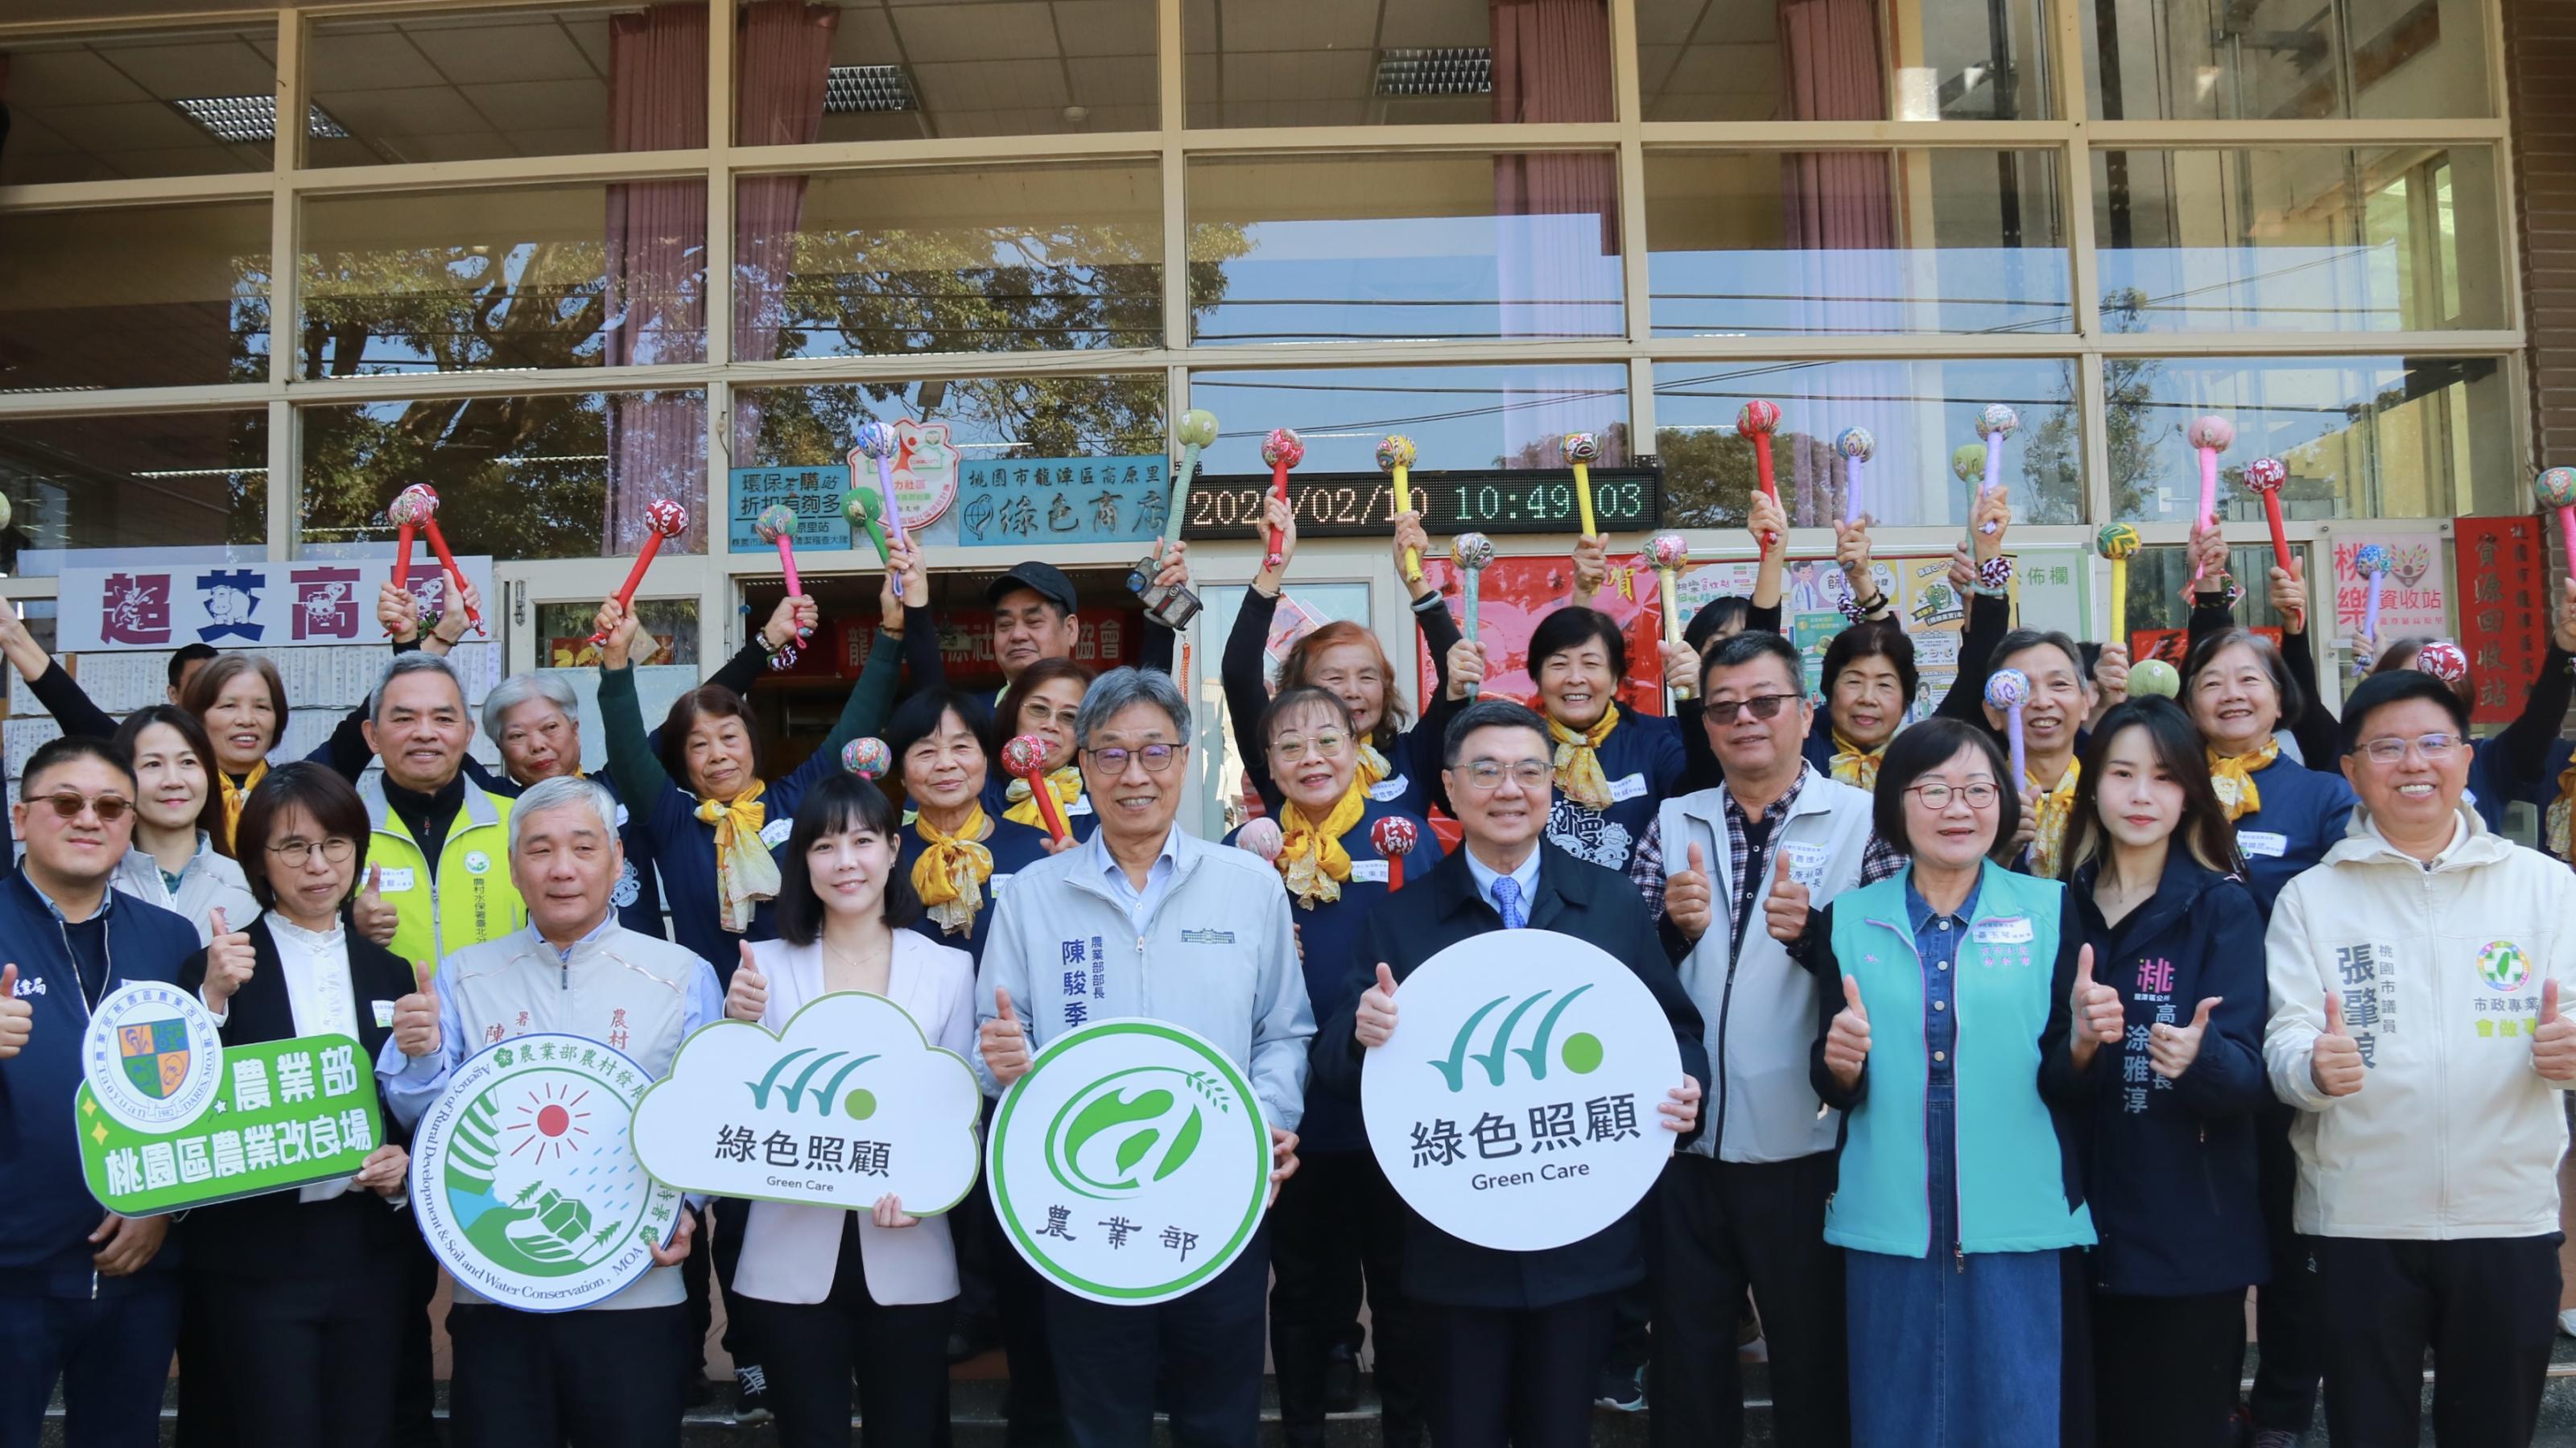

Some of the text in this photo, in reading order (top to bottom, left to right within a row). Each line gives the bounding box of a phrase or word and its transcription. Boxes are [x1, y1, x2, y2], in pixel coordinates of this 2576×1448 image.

[968, 464, 1160, 489] 桃園市龍潭區高原里
[999, 489, 1166, 538] 綠色商店
[1192, 486, 1429, 525] 202/02/10
[2017, 566, 2069, 586] 佈欄
[2474, 532, 2510, 707] 資源回收站
[1062, 939, 1088, 1027] 陳駿季
[1092, 936, 1104, 999] 農業部部長
[2379, 944, 2396, 1034] 桃園市議員
[2473, 996, 2540, 1013] 市政專業
[232, 1044, 358, 1113] 農業部
[453, 1063, 491, 1098] Agency
[2123, 1023, 2151, 1114] 涂雅淳
[98, 1064, 147, 1119] Taoyuan
[444, 1096, 456, 1112] of
[427, 1110, 451, 1144] Rural
[1410, 1092, 1642, 1169] 綠色照顧
[104, 1108, 374, 1198] 桃園區農業改良場
[714, 1124, 892, 1179] 綠色照顧
[419, 1142, 443, 1231] Development
[766, 1175, 835, 1193] Green Care
[1471, 1162, 1591, 1191] Green Care
[437, 1229, 449, 1243] &
[444, 1240, 468, 1264] Soil
[1035, 1204, 1200, 1264] 農業部
[460, 1260, 486, 1281] and
[611, 1248, 644, 1277] MOA
[485, 1270, 521, 1295] Water
